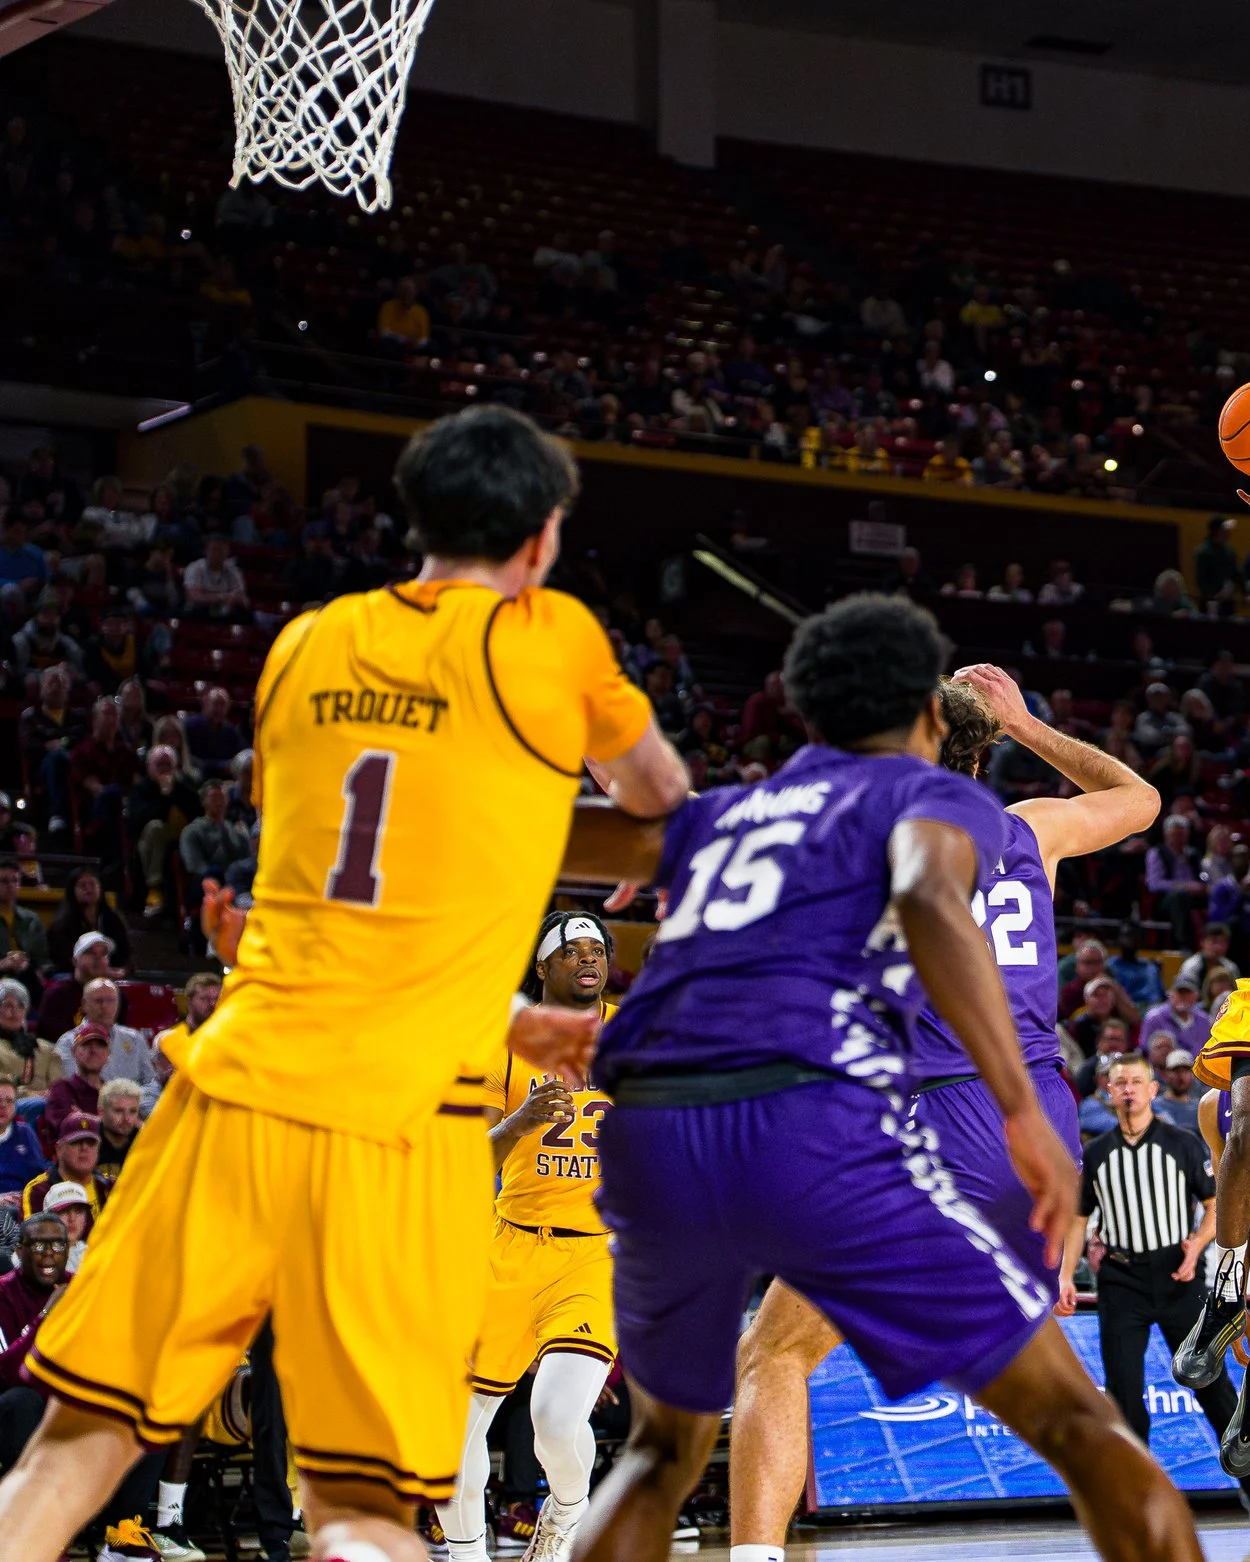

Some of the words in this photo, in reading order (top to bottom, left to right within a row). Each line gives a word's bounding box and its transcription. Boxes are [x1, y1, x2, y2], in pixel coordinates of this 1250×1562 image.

[987, 72, 1024, 102] H1
[310, 688, 449, 733] TROUET
[324, 748, 397, 909] 1
[655, 820, 807, 943] 15
[536, 1153, 603, 1179] STAT
